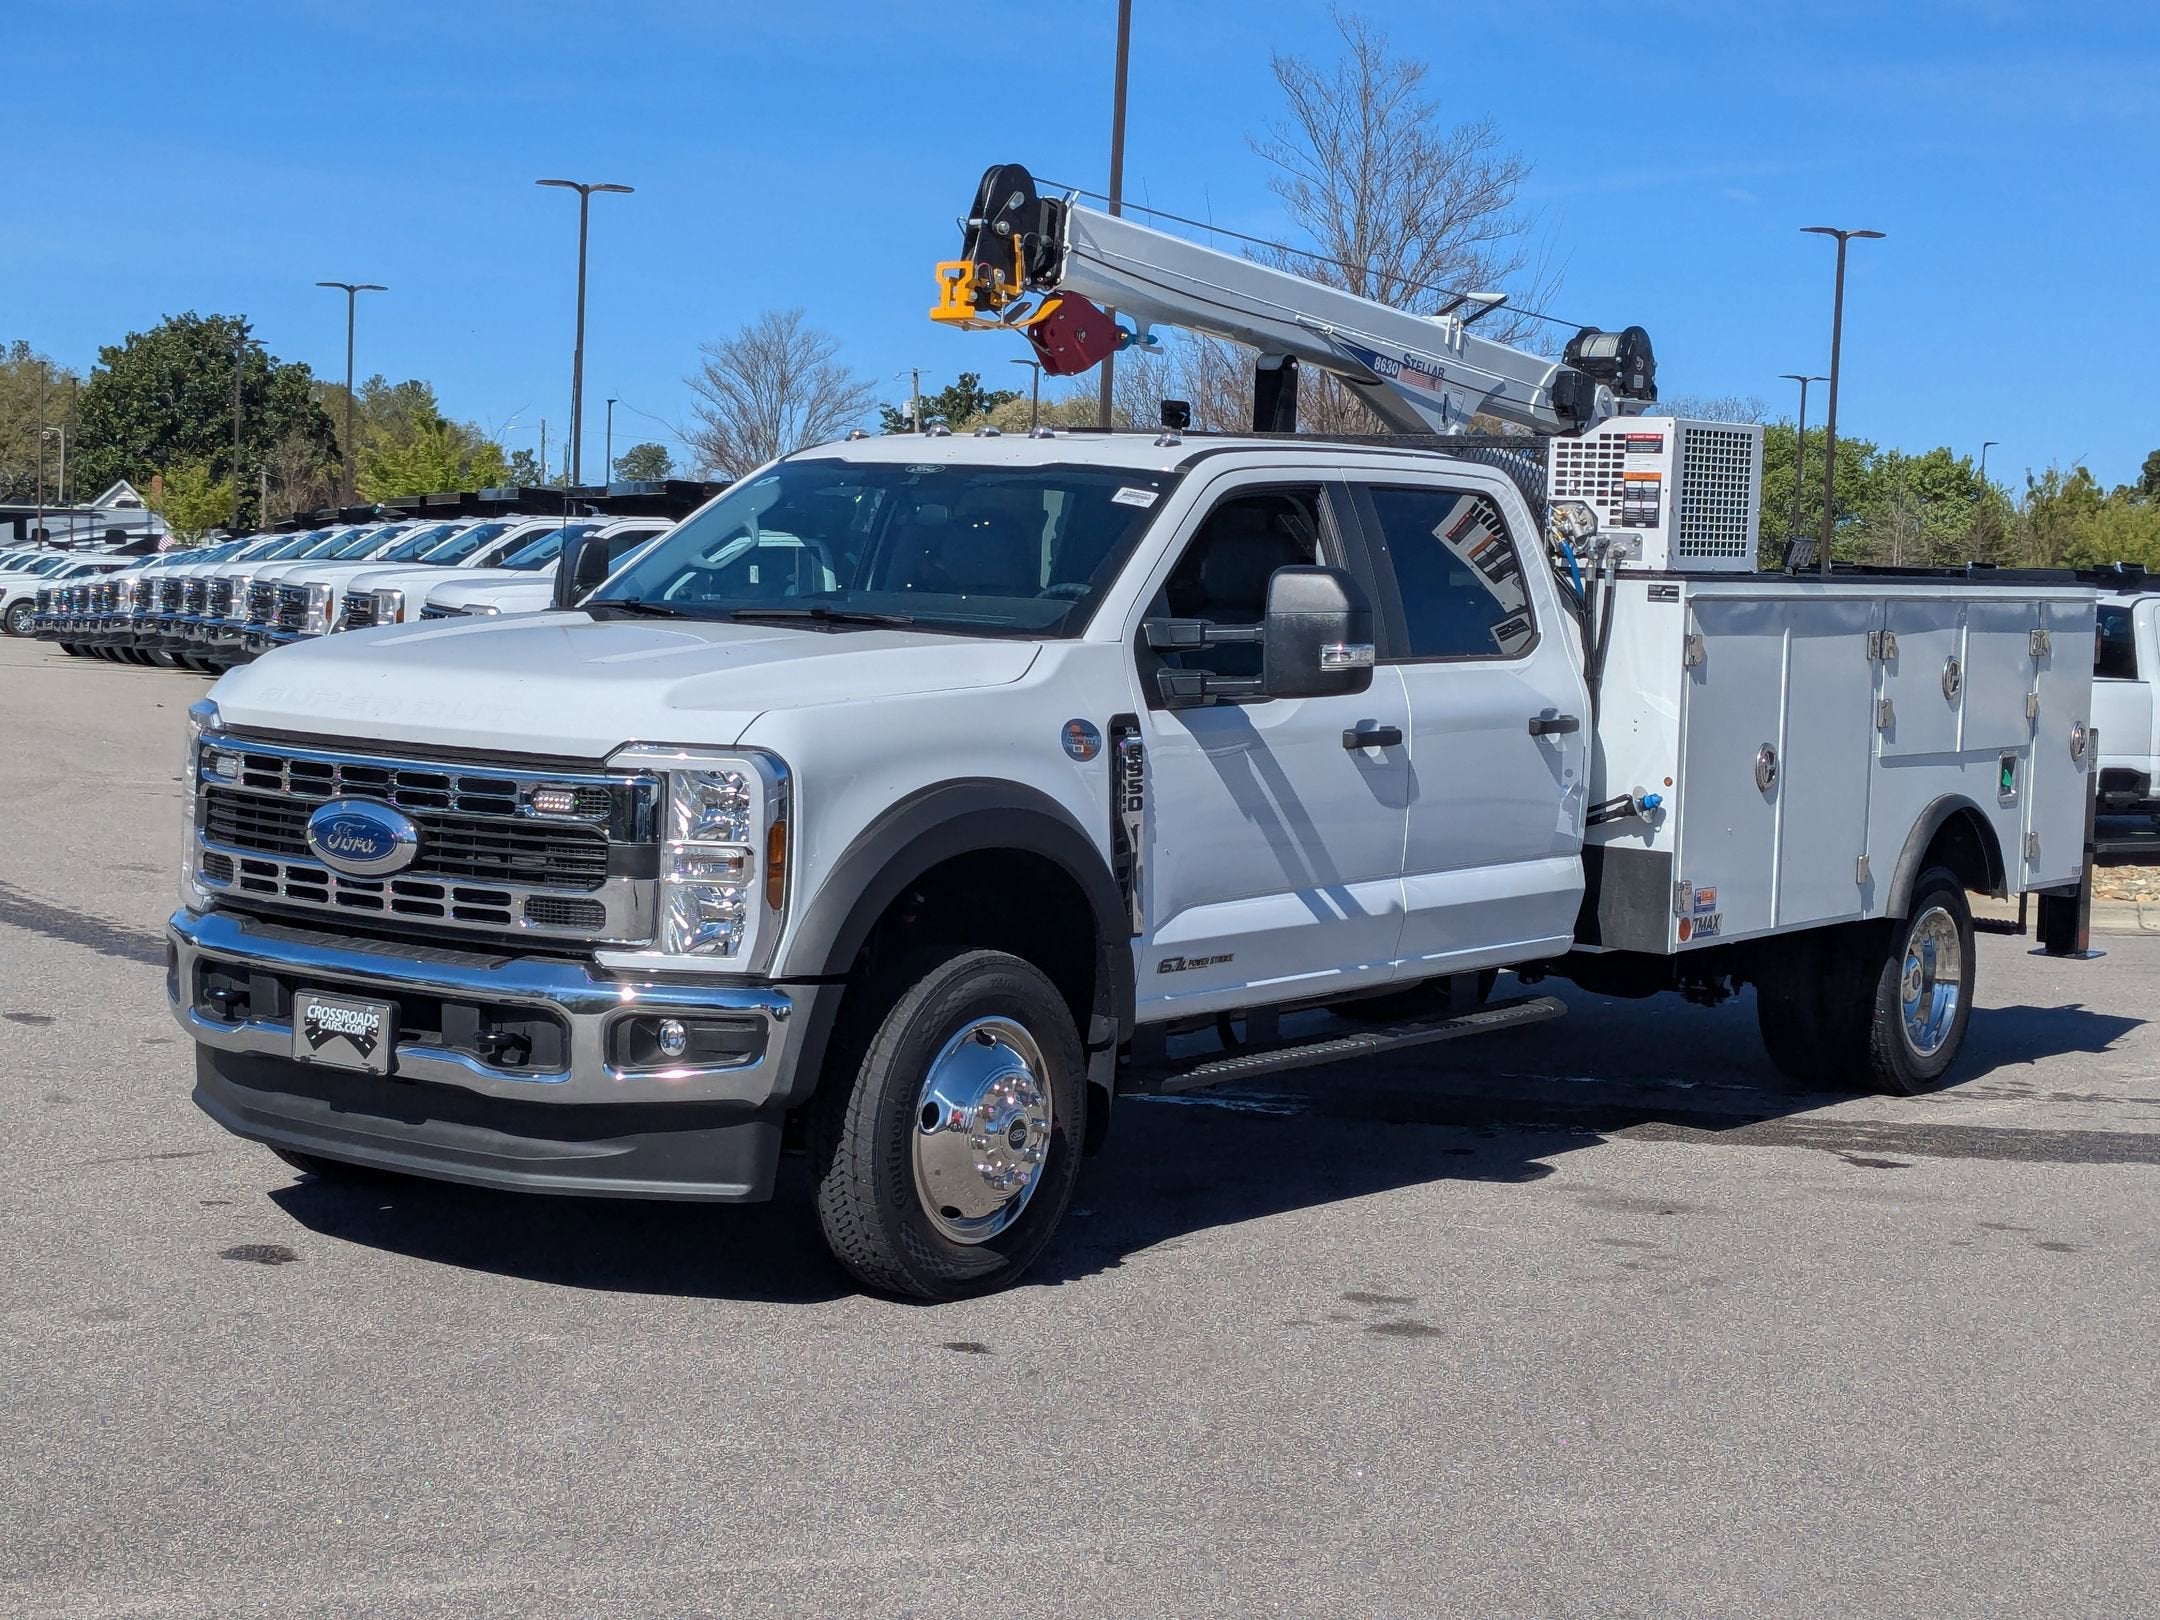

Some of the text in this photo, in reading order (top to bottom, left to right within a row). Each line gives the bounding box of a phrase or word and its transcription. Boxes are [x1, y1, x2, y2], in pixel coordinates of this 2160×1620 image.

[1373, 356, 1399, 376] 8630
[1403, 352, 1445, 378] STELLAR
[327, 820, 378, 854] Ford
[1693, 913, 1721, 933] TMAX
[307, 1004, 380, 1029] CROSSROADS
[319, 1019, 366, 1036] CARS.COM
